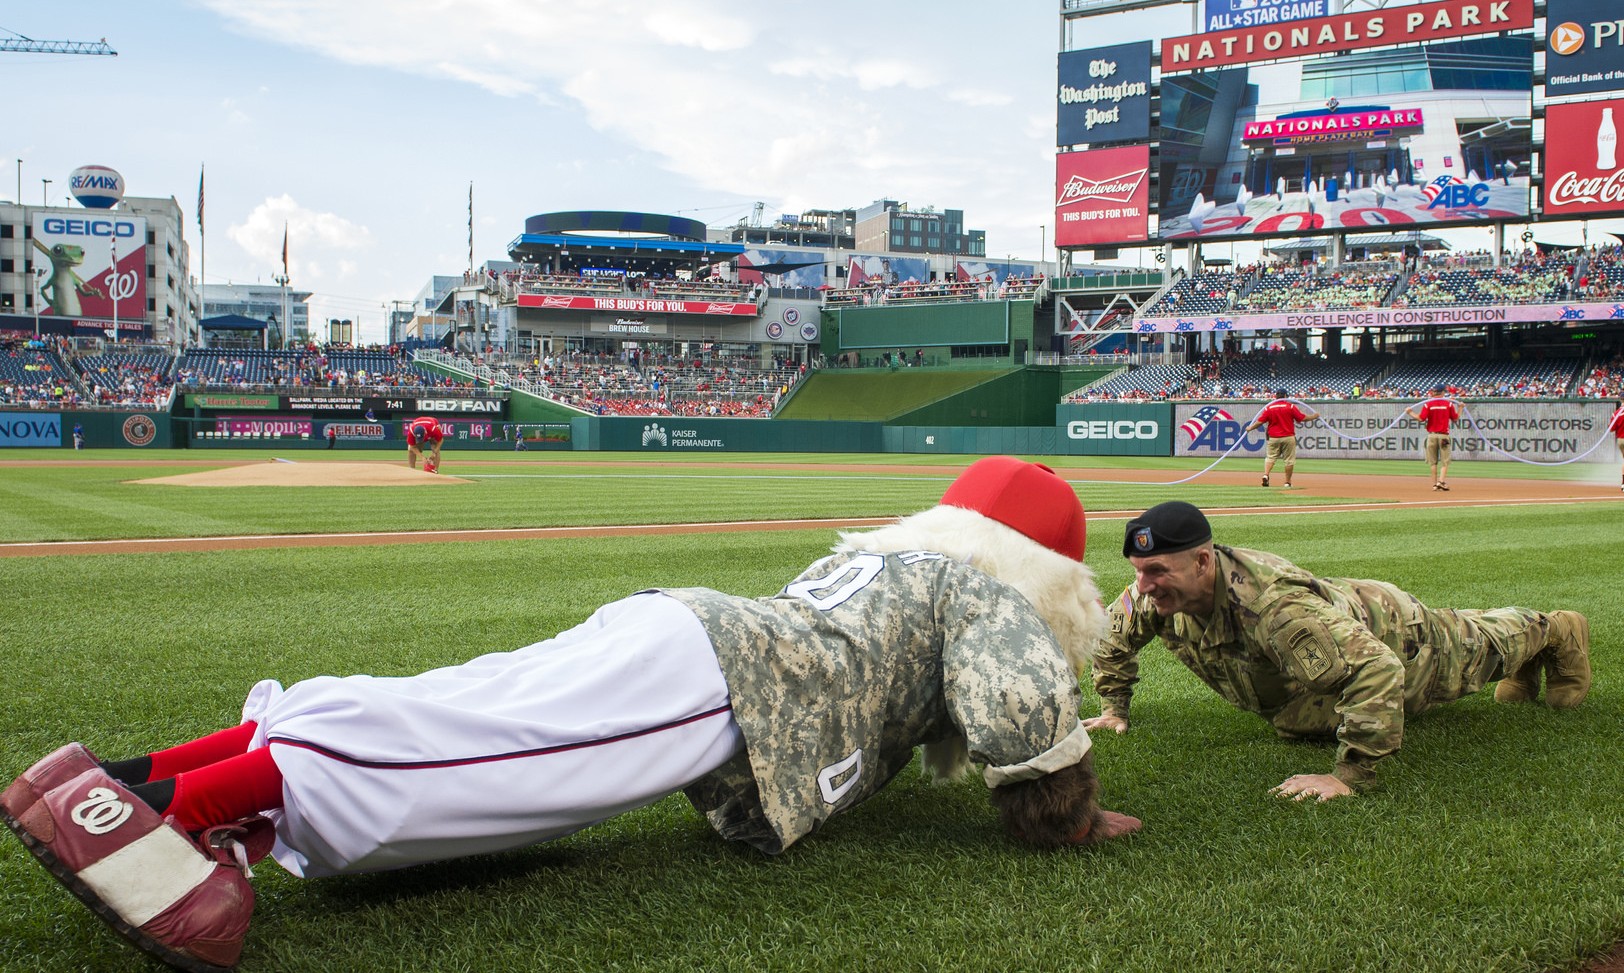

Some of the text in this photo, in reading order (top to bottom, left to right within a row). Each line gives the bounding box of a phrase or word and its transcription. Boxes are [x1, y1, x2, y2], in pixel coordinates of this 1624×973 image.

[1280, 1, 1324, 20] GAME
[1172, 1, 1511, 63] NATIONALS PARK
[1088, 59, 1117, 79] The
[1551, 75, 1580, 85] Official
[1582, 72, 1603, 82] Bank
[1604, 71, 1614, 80] of
[1059, 81, 1147, 104] Washington
[1084, 106, 1120, 130] Post
[1248, 108, 1418, 136] NATIONALS PARK
[1290, 135, 1316, 144] HOME
[71, 174, 118, 190] RE/MAX
[1063, 179, 1137, 198] Budweiser
[1427, 183, 1490, 209] ABC
[1063, 207, 1141, 222] THIS BUD'S FOR YOU.
[44, 218, 135, 237] GEICO
[593, 299, 686, 312] THIS BUD'S FOR YOU.
[1287, 309, 1506, 327] EXCELLENCE IN CONSTRUCTION
[1559, 309, 1585, 320] ABC
[77, 320, 103, 328] ADVANCE
[628, 325, 650, 333] HOUSE
[1138, 323, 1157, 332] ABC
[1174, 322, 1194, 331] ABC
[1212, 321, 1233, 330] ABC
[386, 401, 403, 409] 7:41
[461, 400, 501, 412] FAN
[1067, 420, 1159, 440] GEICO
[1367, 418, 1427, 430] BUILDER
[1477, 418, 1593, 431] CONTRACTORS
[459, 430, 468, 440] 377
[671, 430, 697, 438] KAISER
[925, 435, 935, 445] 402
[1187, 420, 1265, 451] ABC
[1295, 436, 1397, 450] XCELLENCE
[1401, 436, 1419, 450] IN
